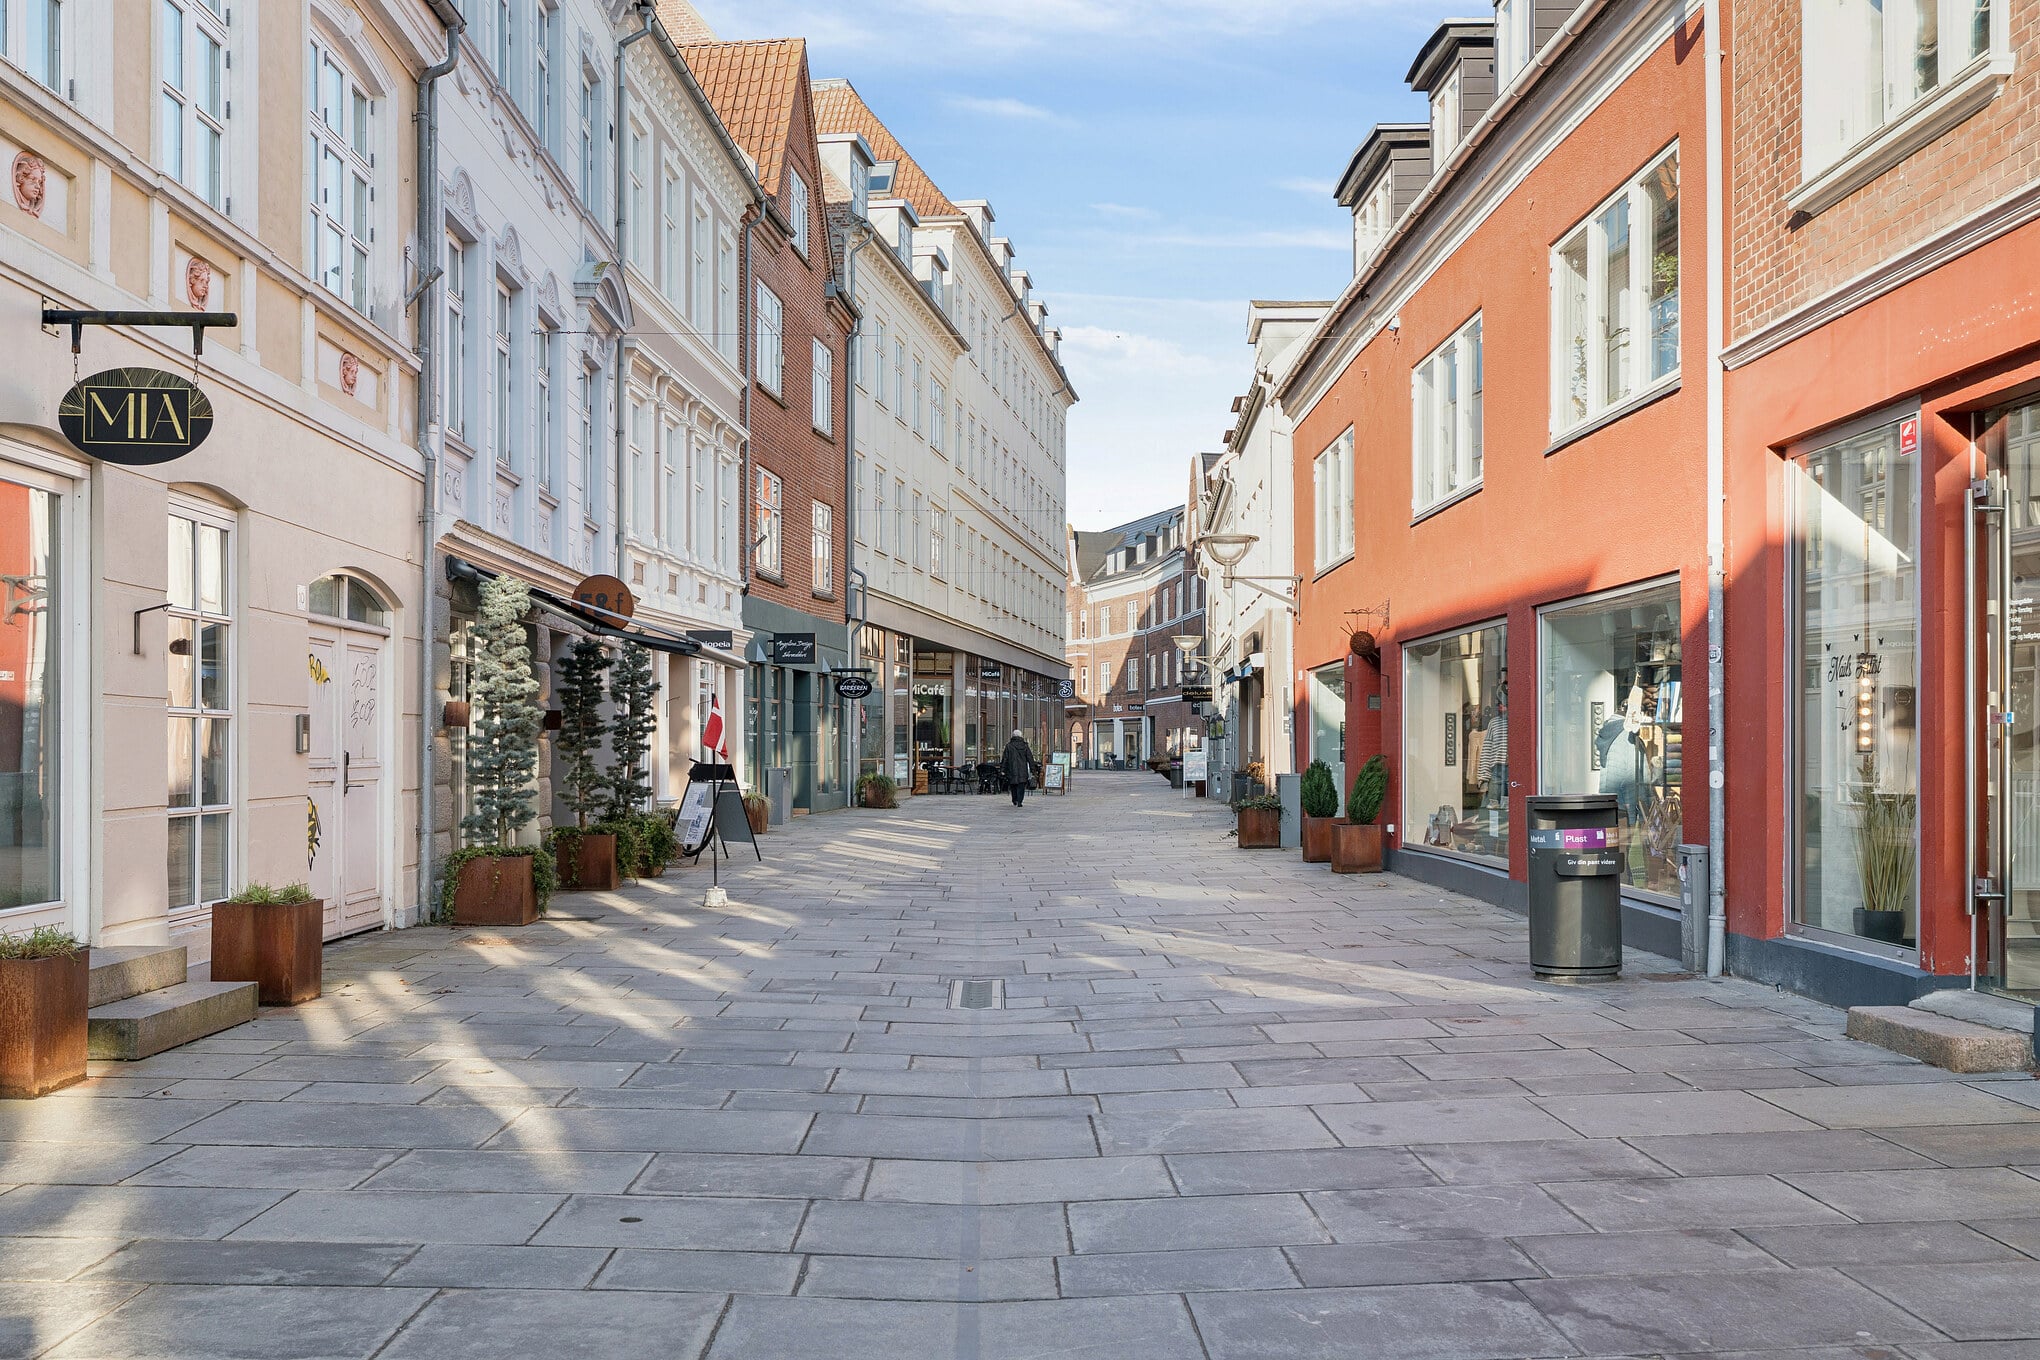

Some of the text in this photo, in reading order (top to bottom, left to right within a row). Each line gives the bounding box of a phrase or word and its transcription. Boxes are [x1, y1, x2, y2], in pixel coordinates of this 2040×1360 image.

[90, 392, 185, 440] MIA
[1828, 654, 1852, 682] Nails
[1565, 835, 1588, 843] Plast
